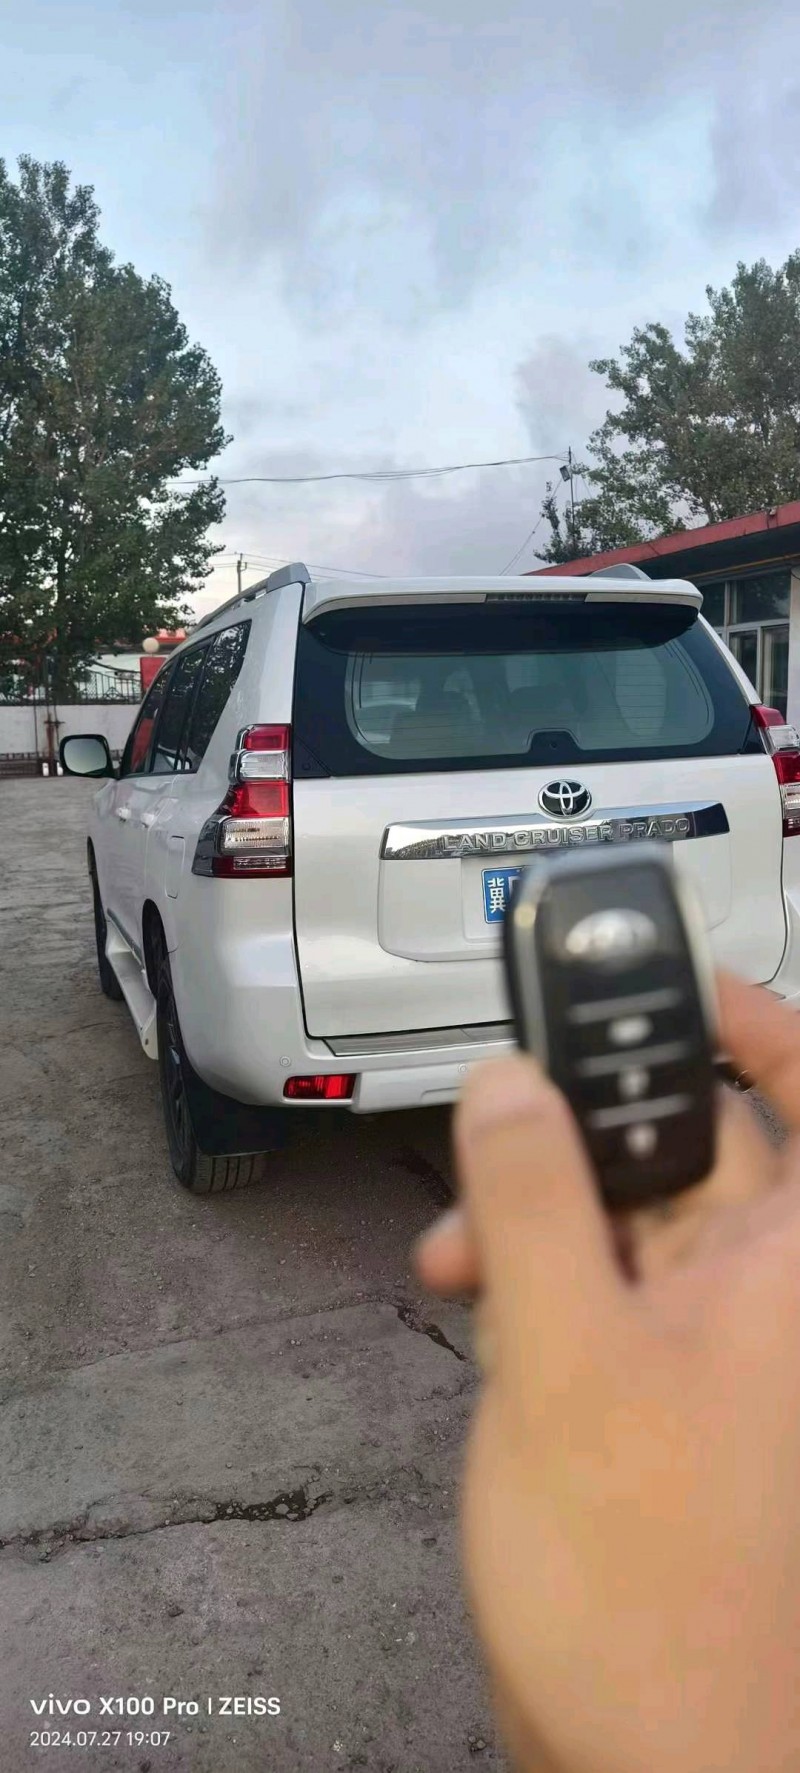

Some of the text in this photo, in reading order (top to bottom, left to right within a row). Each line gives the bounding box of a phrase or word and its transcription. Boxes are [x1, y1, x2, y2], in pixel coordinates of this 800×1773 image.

[443, 817, 690, 851] LAND CRUISER PRADO
